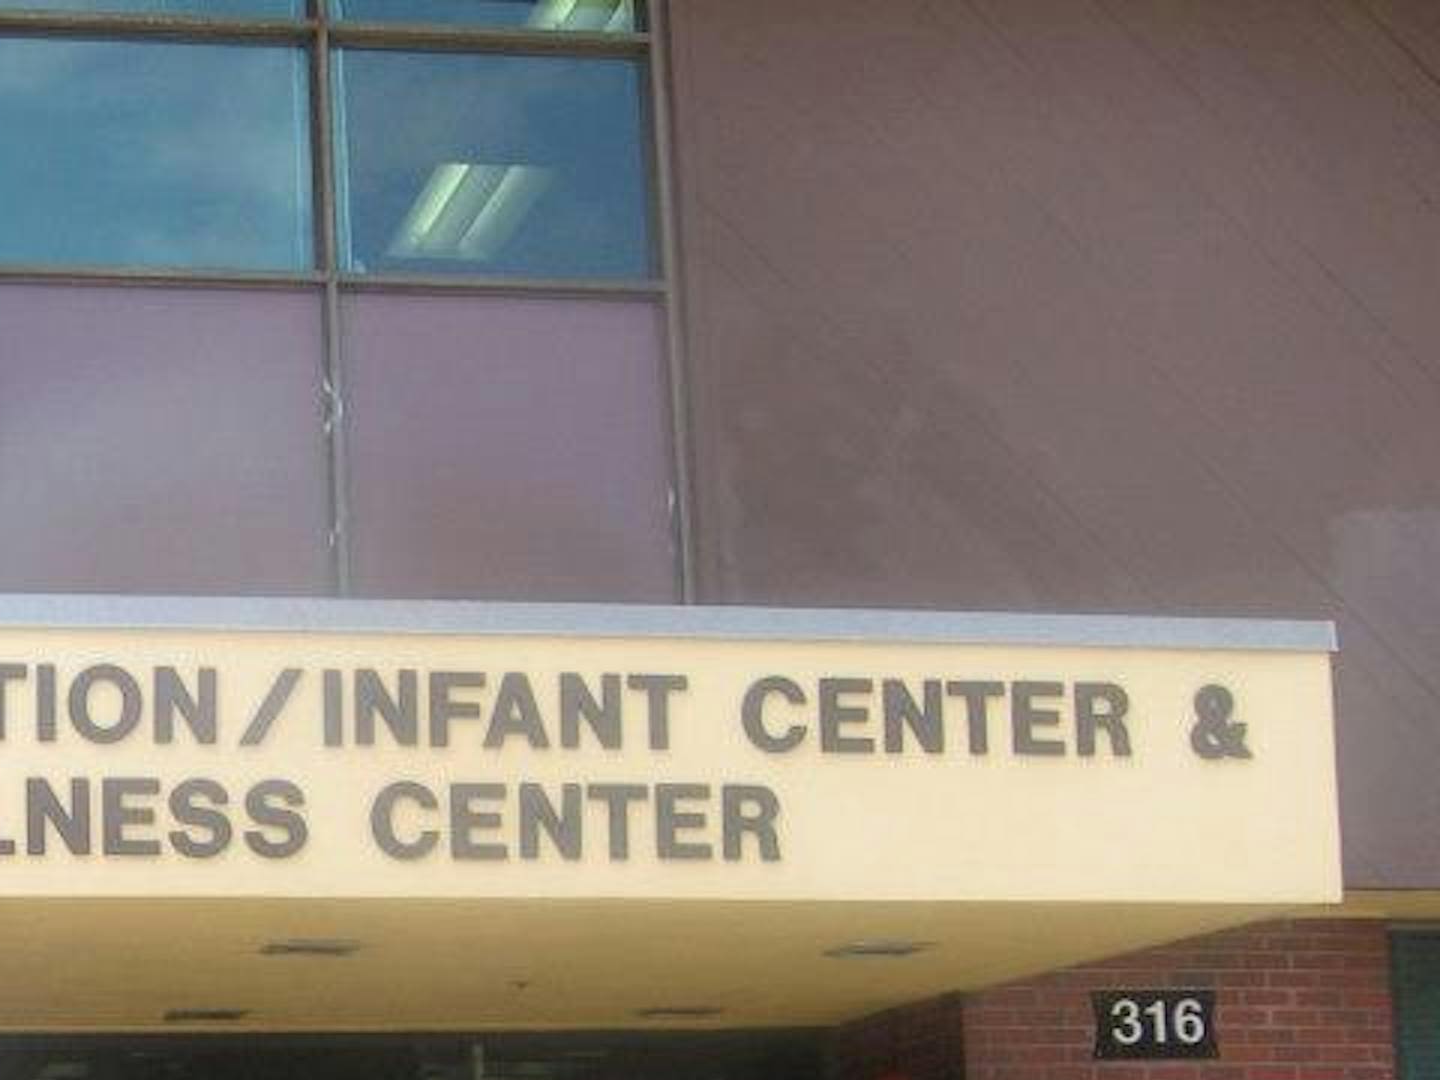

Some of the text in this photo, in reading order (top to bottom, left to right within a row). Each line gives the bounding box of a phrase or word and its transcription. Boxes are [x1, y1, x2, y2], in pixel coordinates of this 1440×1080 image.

[741, 676, 1131, 757] CENTER
[1190, 684, 1251, 759] &
[372, 782, 780, 861] CENTER
[1111, 997, 1206, 1046] 316
